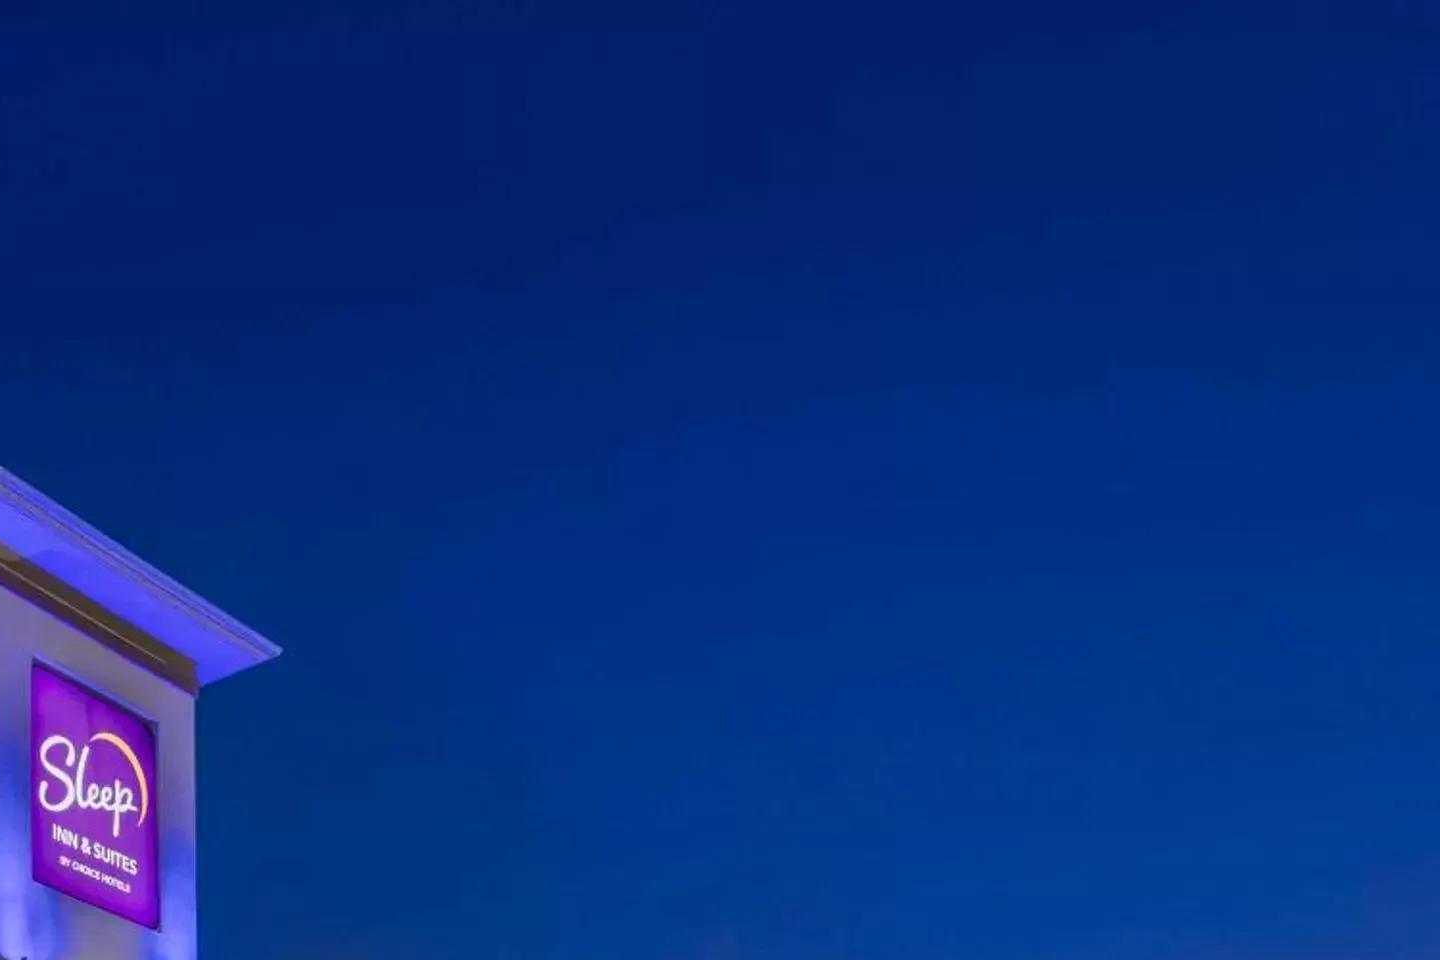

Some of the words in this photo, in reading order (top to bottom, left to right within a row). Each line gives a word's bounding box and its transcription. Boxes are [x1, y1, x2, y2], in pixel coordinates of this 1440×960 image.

[39, 734, 138, 837] Sleep
[53, 823, 78, 850] INN
[81, 836, 91, 855] &
[93, 842, 137, 876] SUITES
